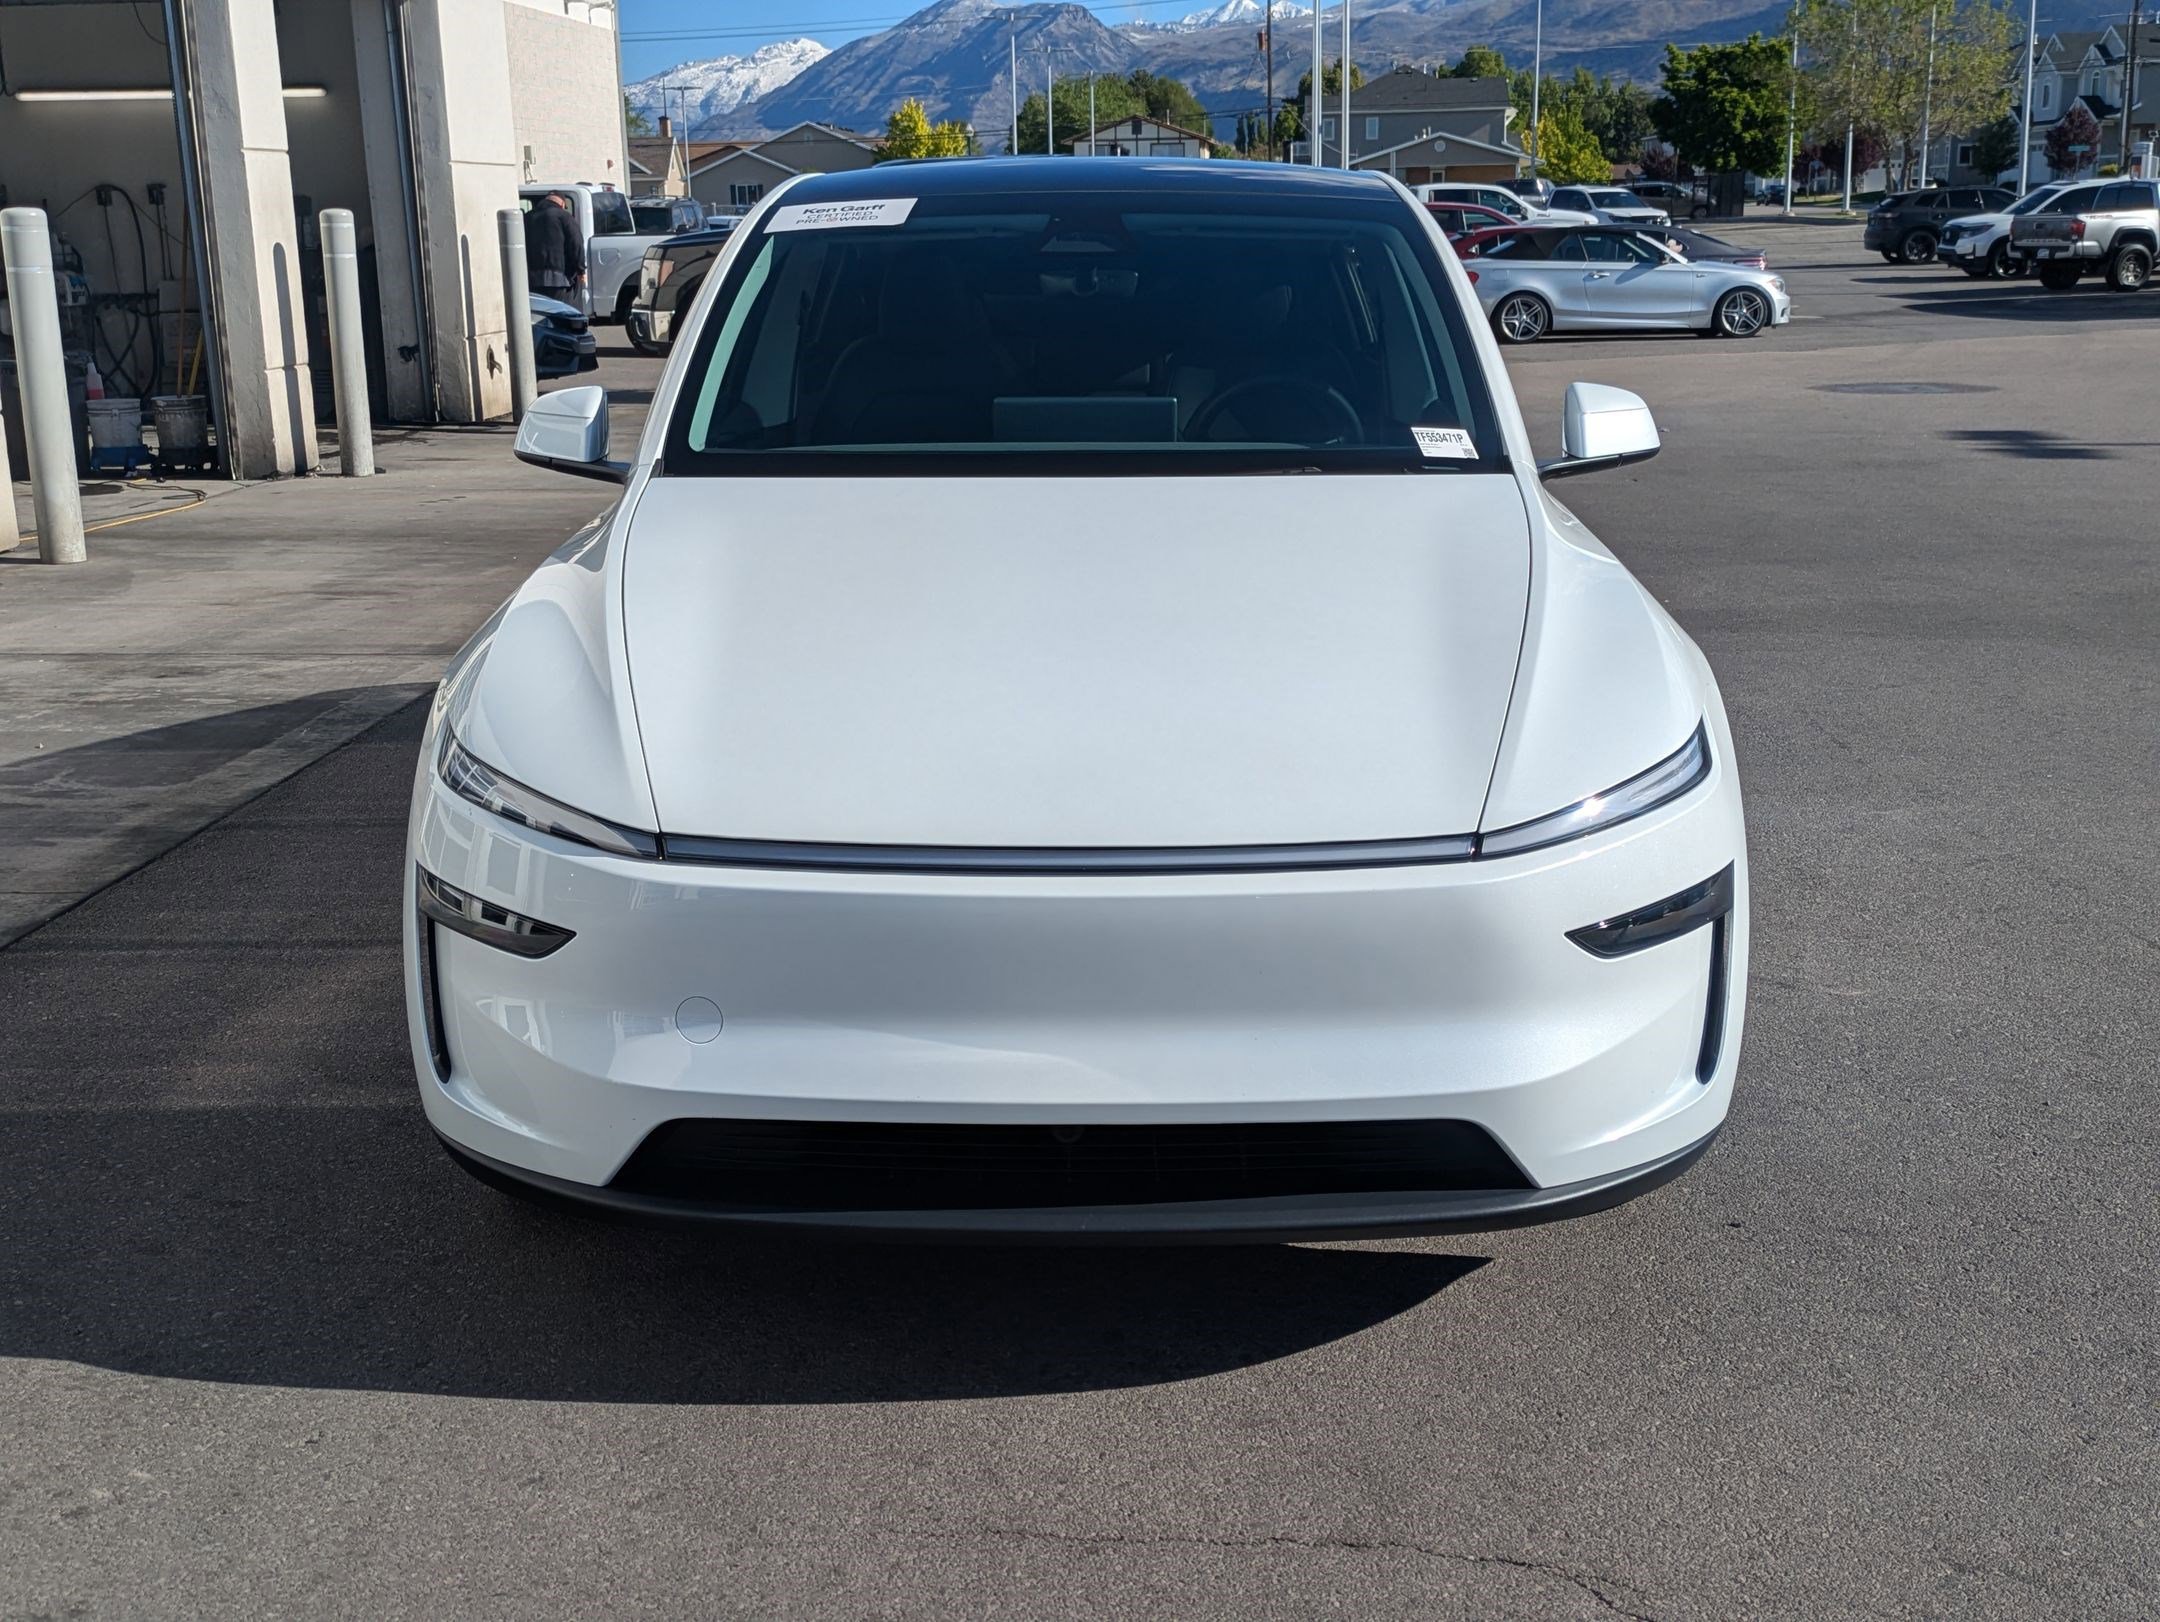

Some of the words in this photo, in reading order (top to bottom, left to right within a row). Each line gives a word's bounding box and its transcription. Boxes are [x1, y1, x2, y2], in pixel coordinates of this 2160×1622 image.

[840, 204, 885, 212] Garff
[807, 211, 873, 219] CERTIFIED
[1415, 432, 1463, 443] TF553471P
